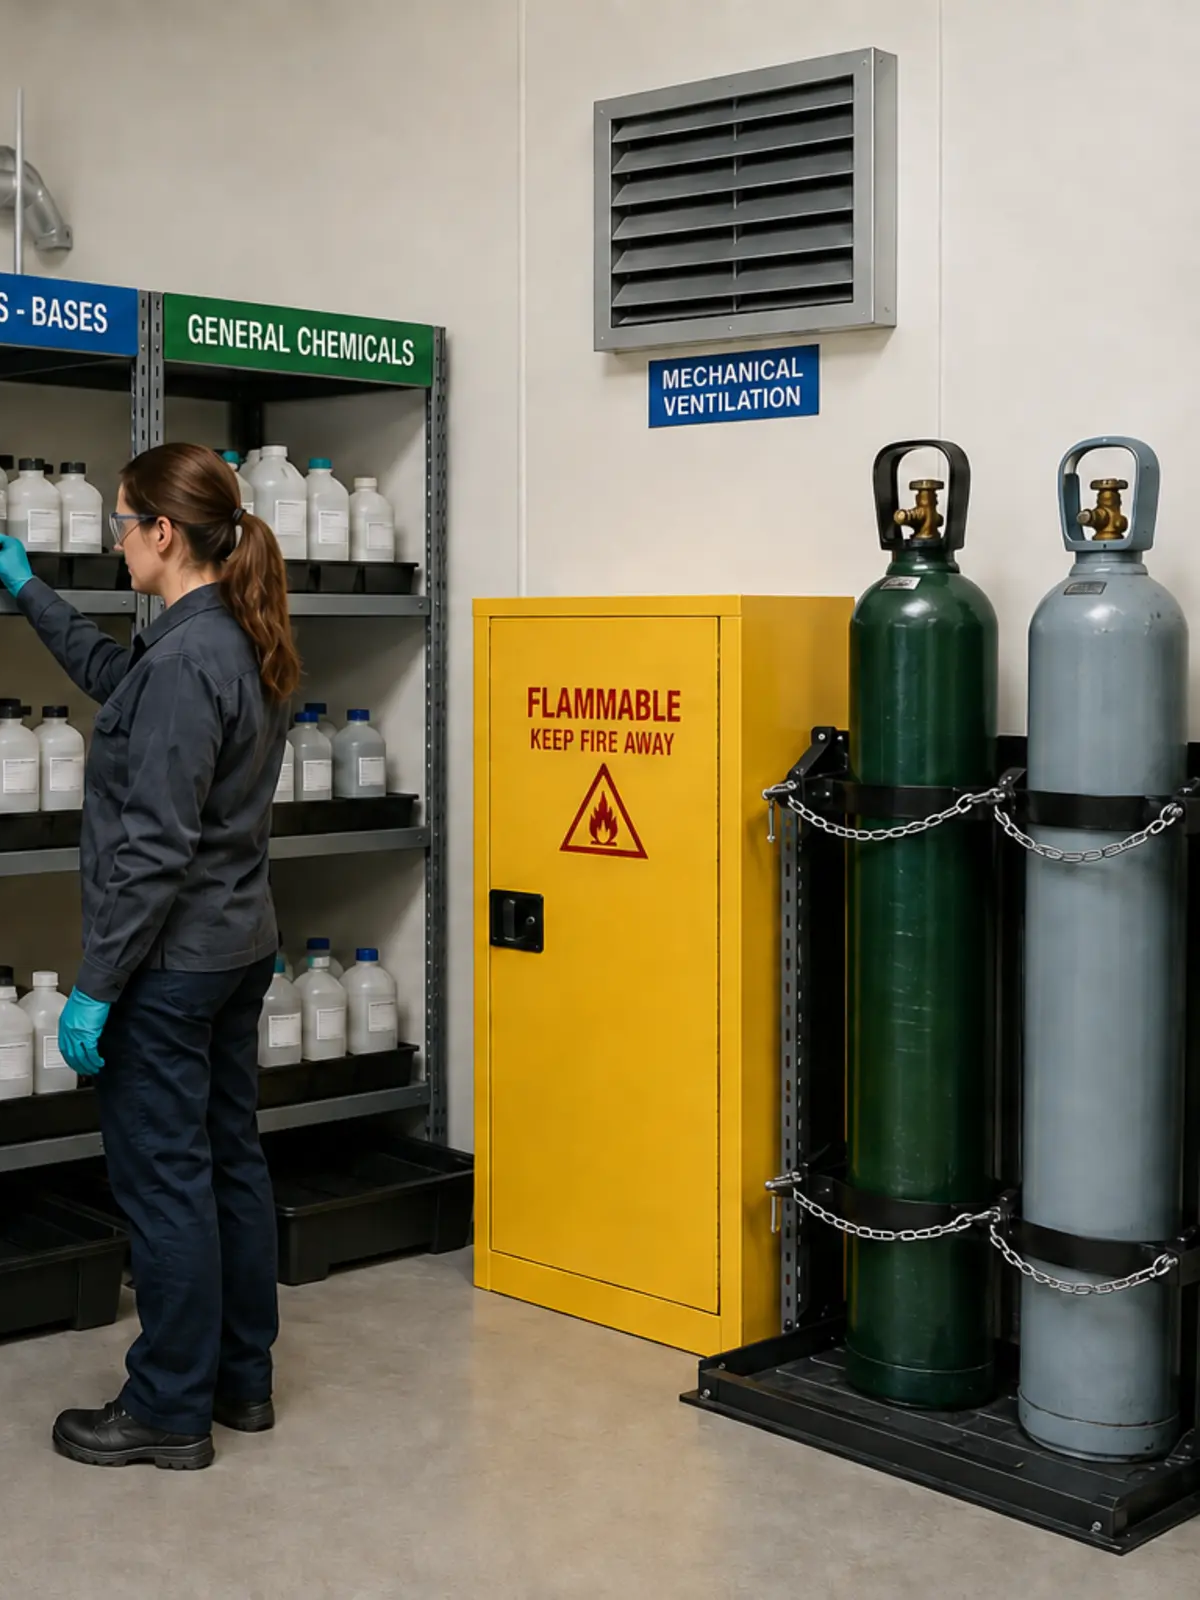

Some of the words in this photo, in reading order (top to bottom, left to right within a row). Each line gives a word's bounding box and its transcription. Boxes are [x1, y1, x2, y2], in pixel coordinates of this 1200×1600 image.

[31, 296, 108, 334] BASES
[188, 314, 290, 353] GENERAL
[297, 326, 415, 367] CHEMICALS
[662, 357, 804, 390] MECHANICAL
[664, 386, 801, 416] VENTILATION
[527, 687, 681, 722] FLAMMABLE
[530, 728, 574, 751] KEEP
[580, 730, 618, 753] FIRE
[624, 731, 675, 756] AWAY
